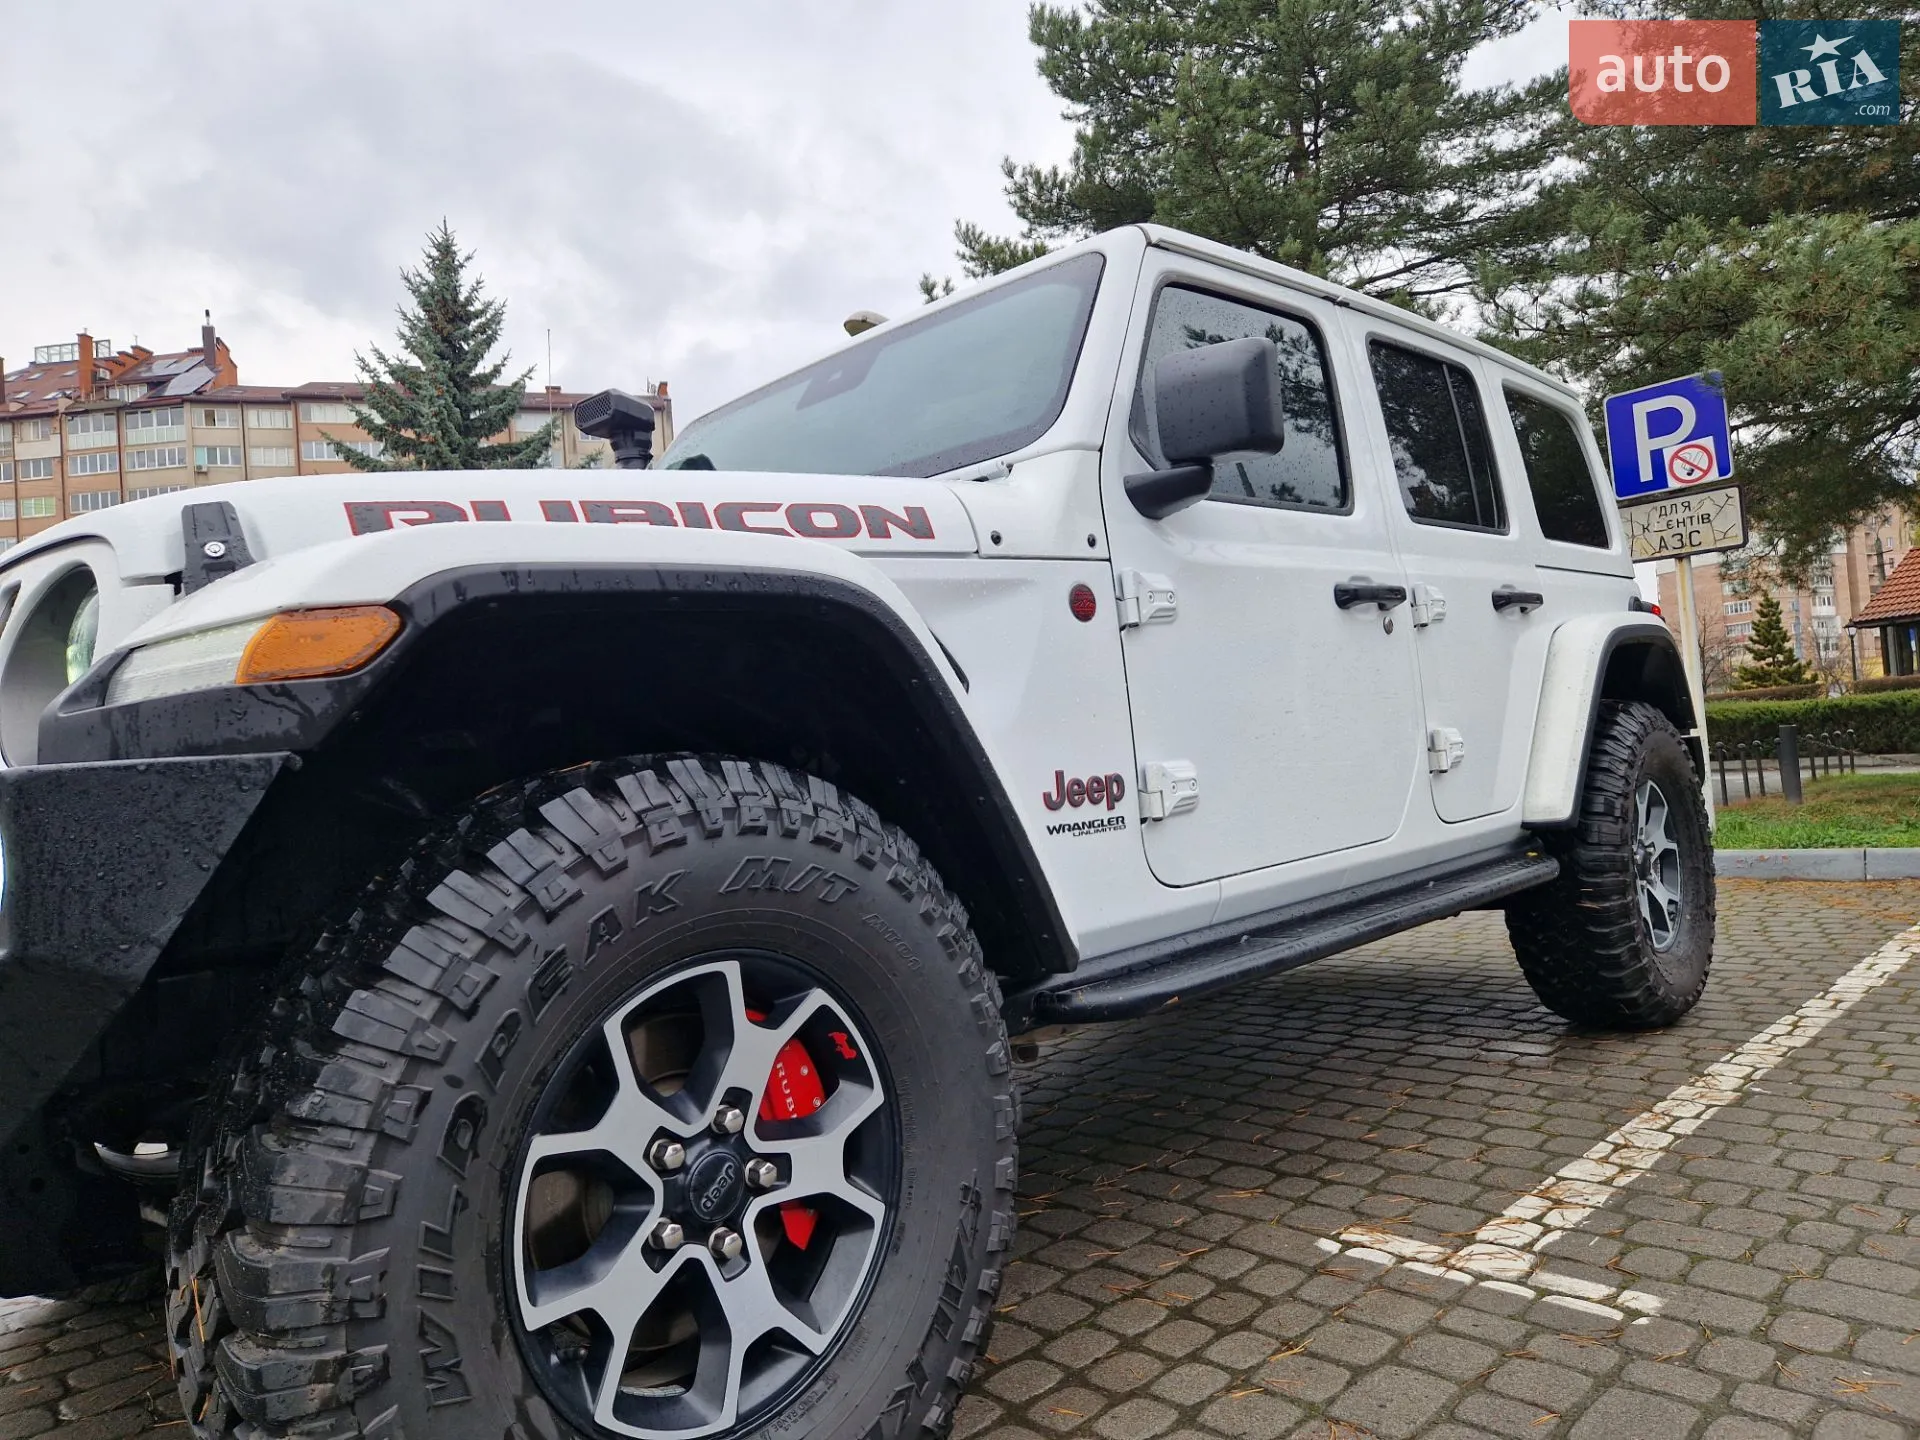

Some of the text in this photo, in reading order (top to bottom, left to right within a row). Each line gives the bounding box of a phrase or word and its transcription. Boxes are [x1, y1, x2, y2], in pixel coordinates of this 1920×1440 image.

[1632, 394, 1696, 483] P
[1658, 500, 1692, 518] ДЛЯ
[1642, 512, 1712, 534] КЄНТІВ
[1658, 530, 1702, 551] АЗС
[1043, 769, 1125, 811] Jeep
[1046, 815, 1126, 836] WRANGLER
[1072, 824, 1126, 837] UNLIMITED
[700, 1162, 735, 1213] Jeep
